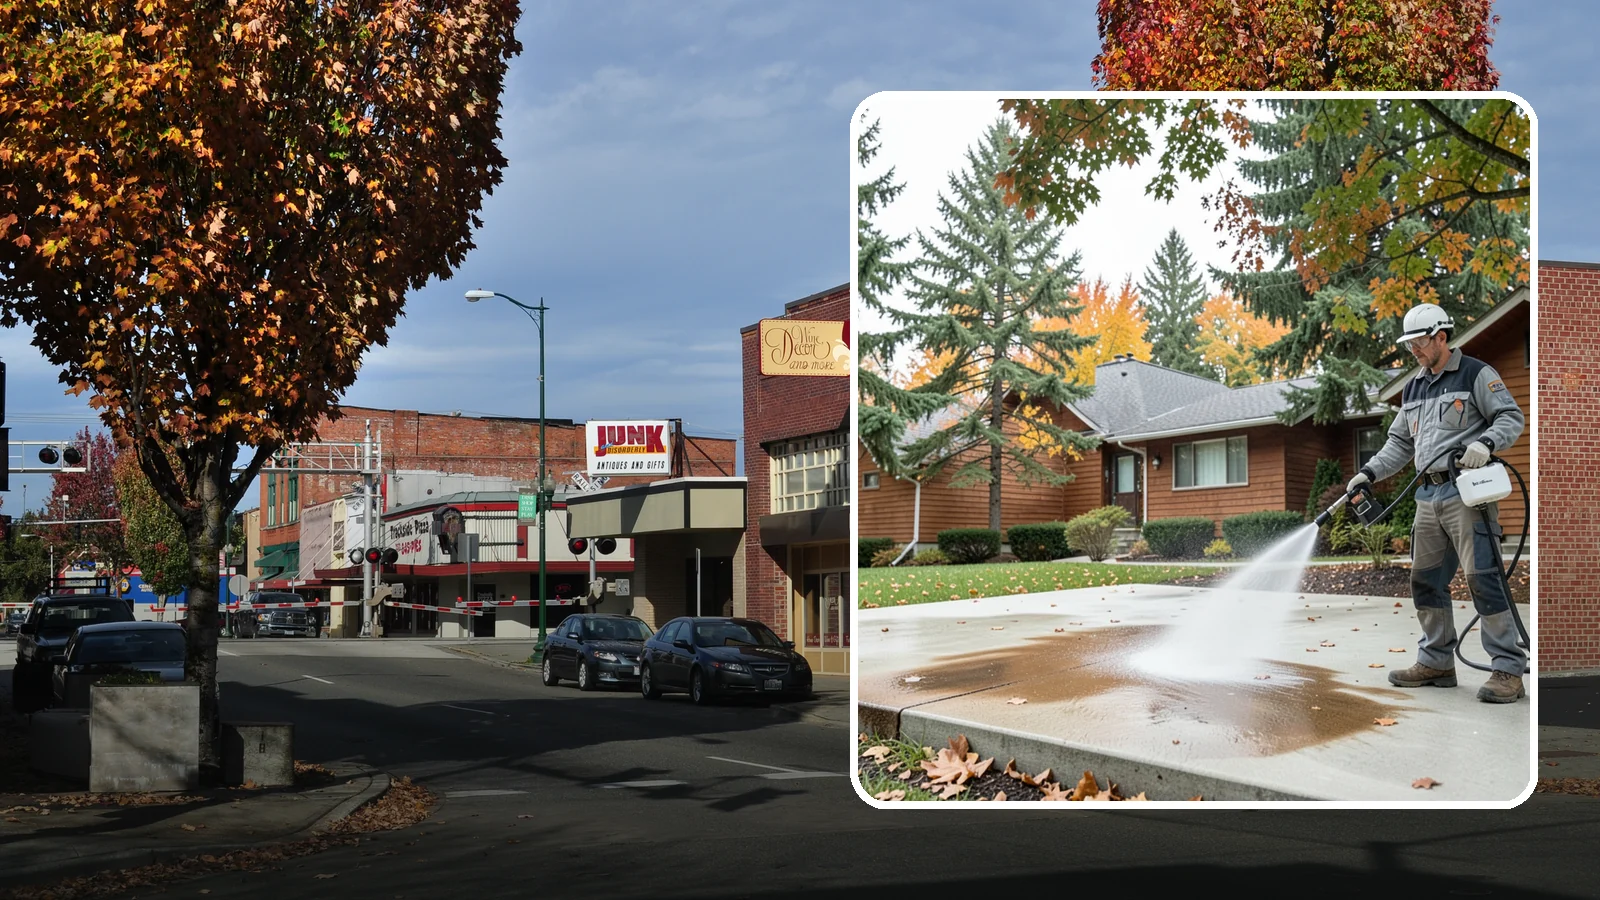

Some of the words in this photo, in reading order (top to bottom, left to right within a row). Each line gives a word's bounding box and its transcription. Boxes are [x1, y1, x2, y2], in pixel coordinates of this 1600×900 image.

[596, 425, 664, 457] JUNK
[607, 446, 646, 454] DISORDERLY
[597, 461, 627, 470] ANTIQUES
[631, 460, 644, 470] AND
[647, 460, 665, 469] GIFTS
[415, 519, 429, 534] Pizza
